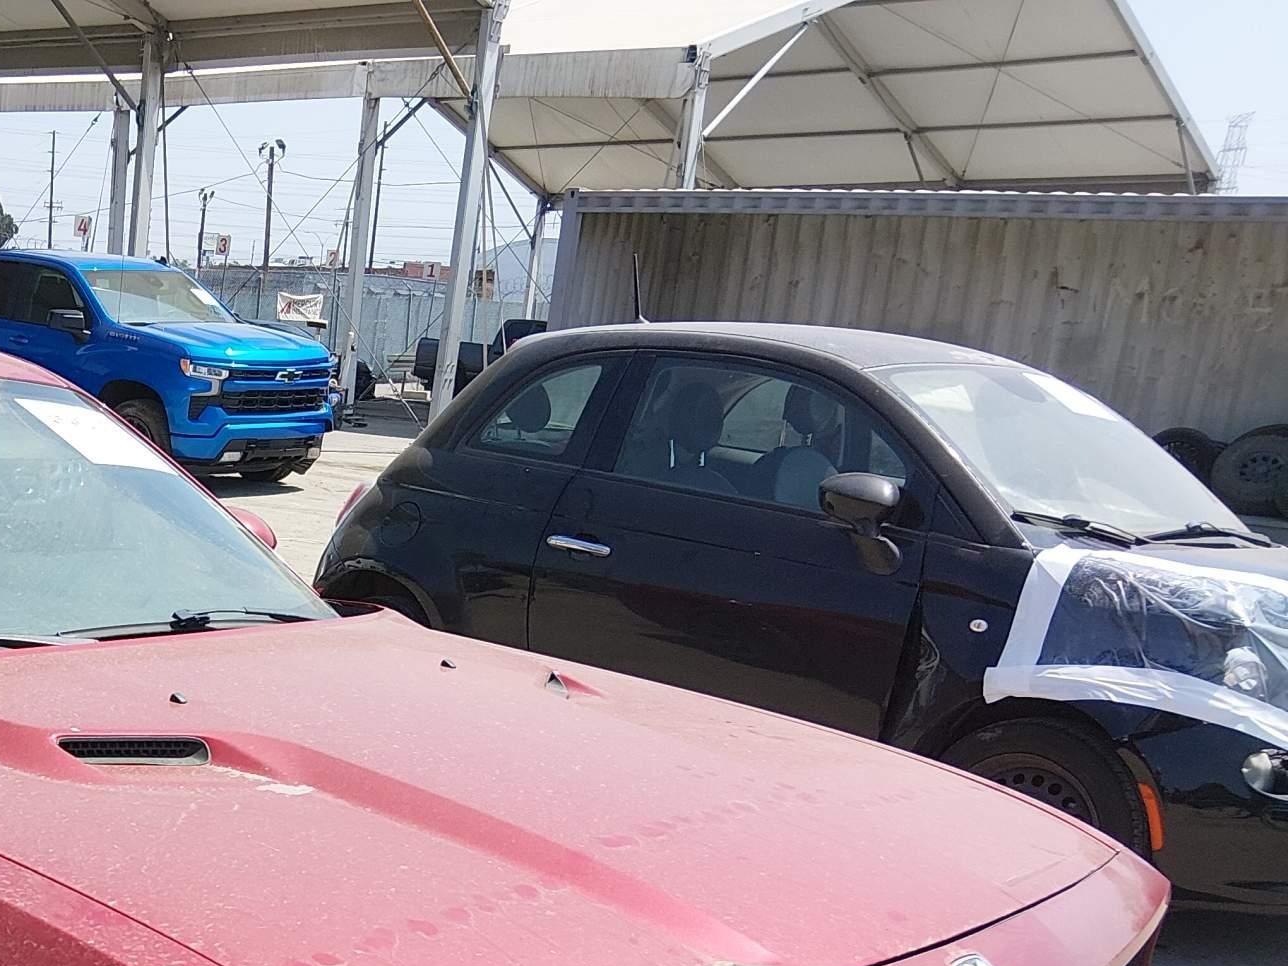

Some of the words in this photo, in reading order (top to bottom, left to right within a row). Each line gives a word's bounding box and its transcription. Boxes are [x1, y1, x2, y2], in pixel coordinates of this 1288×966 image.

[77, 218, 88, 235] 4
[219, 237, 228, 253] 3
[328, 251, 338, 266] 2
[426, 263, 436, 277] 1
